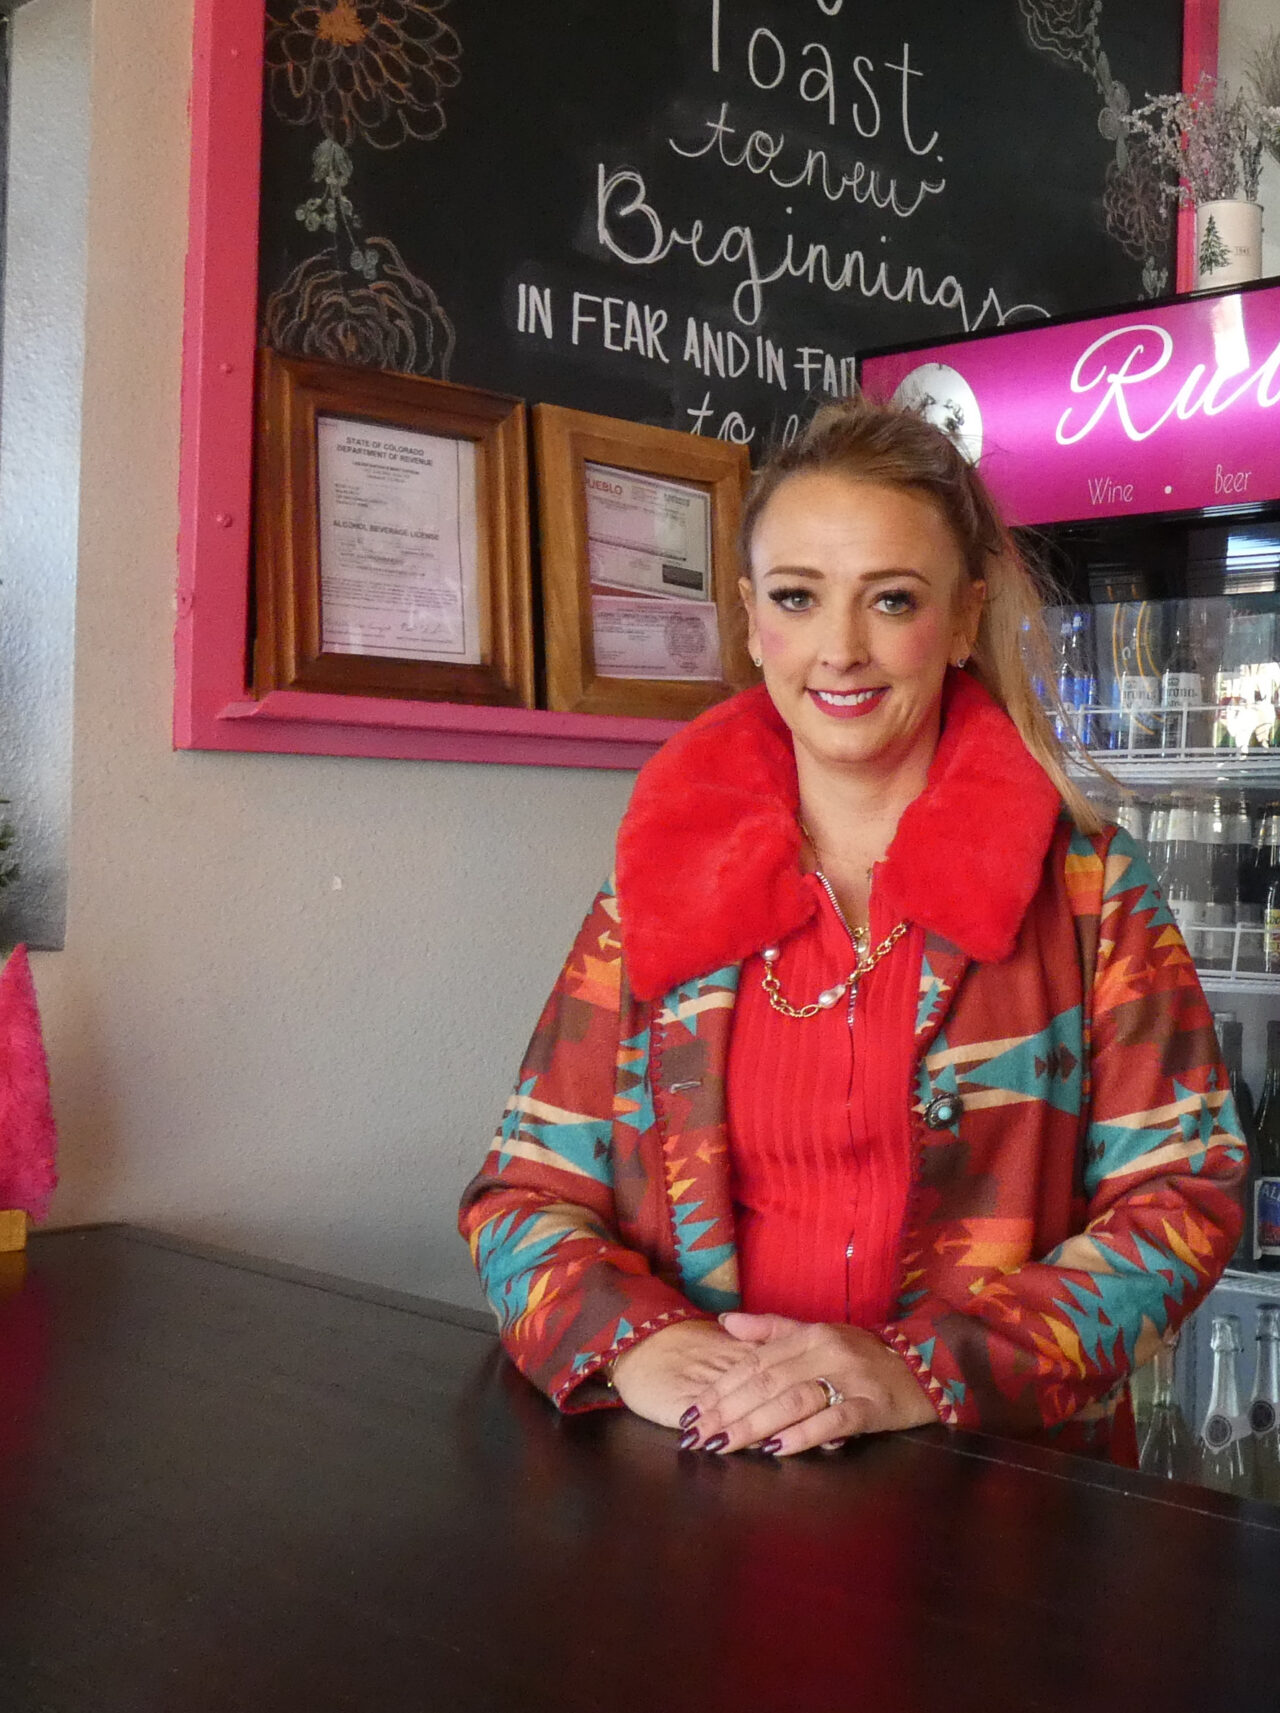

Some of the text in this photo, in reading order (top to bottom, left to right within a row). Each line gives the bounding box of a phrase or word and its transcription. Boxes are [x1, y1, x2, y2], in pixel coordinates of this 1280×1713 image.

[669, 102, 946, 217] to new
[516, 283, 553, 339] IN
[571, 291, 670, 364] FEAR
[684, 317, 750, 378] AND
[756, 335, 787, 390] IN
[336, 444, 387, 459] DEPARTMENT
[400, 454, 433, 467] REVENUE
[346, 436, 424, 456] STATE OF COLORADO
[1087, 477, 1136, 506] Wine
[1214, 463, 1253, 496] Beer
[333, 520, 440, 541] ALCOHOL BEVERAGE LICENSE
